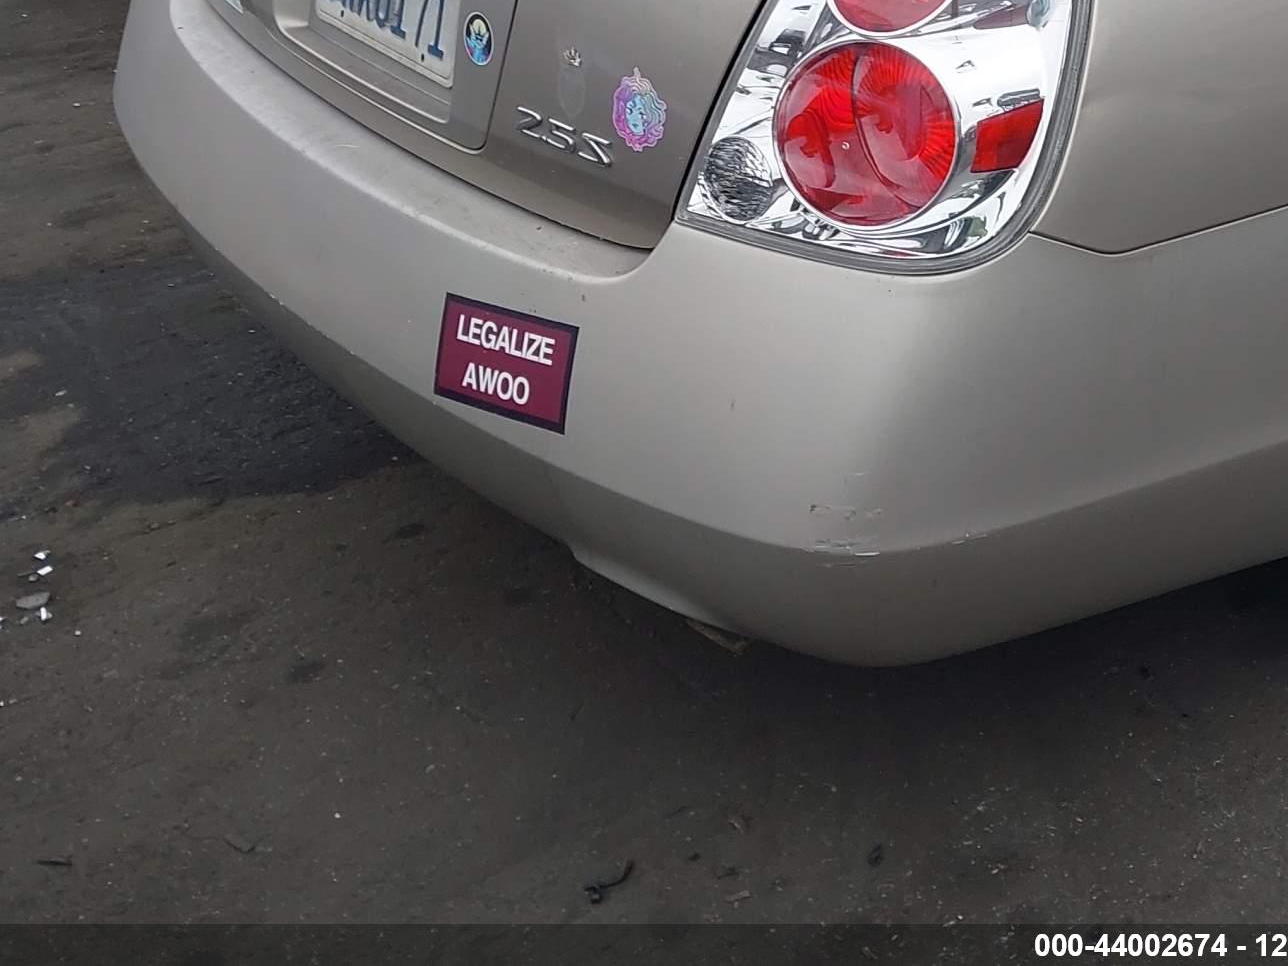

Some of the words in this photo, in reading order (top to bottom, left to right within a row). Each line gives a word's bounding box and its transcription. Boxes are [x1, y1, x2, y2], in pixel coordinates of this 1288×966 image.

[578, 132, 613, 168] S
[456, 314, 556, 366] LEGALIZE
[462, 362, 530, 405] AWOO
